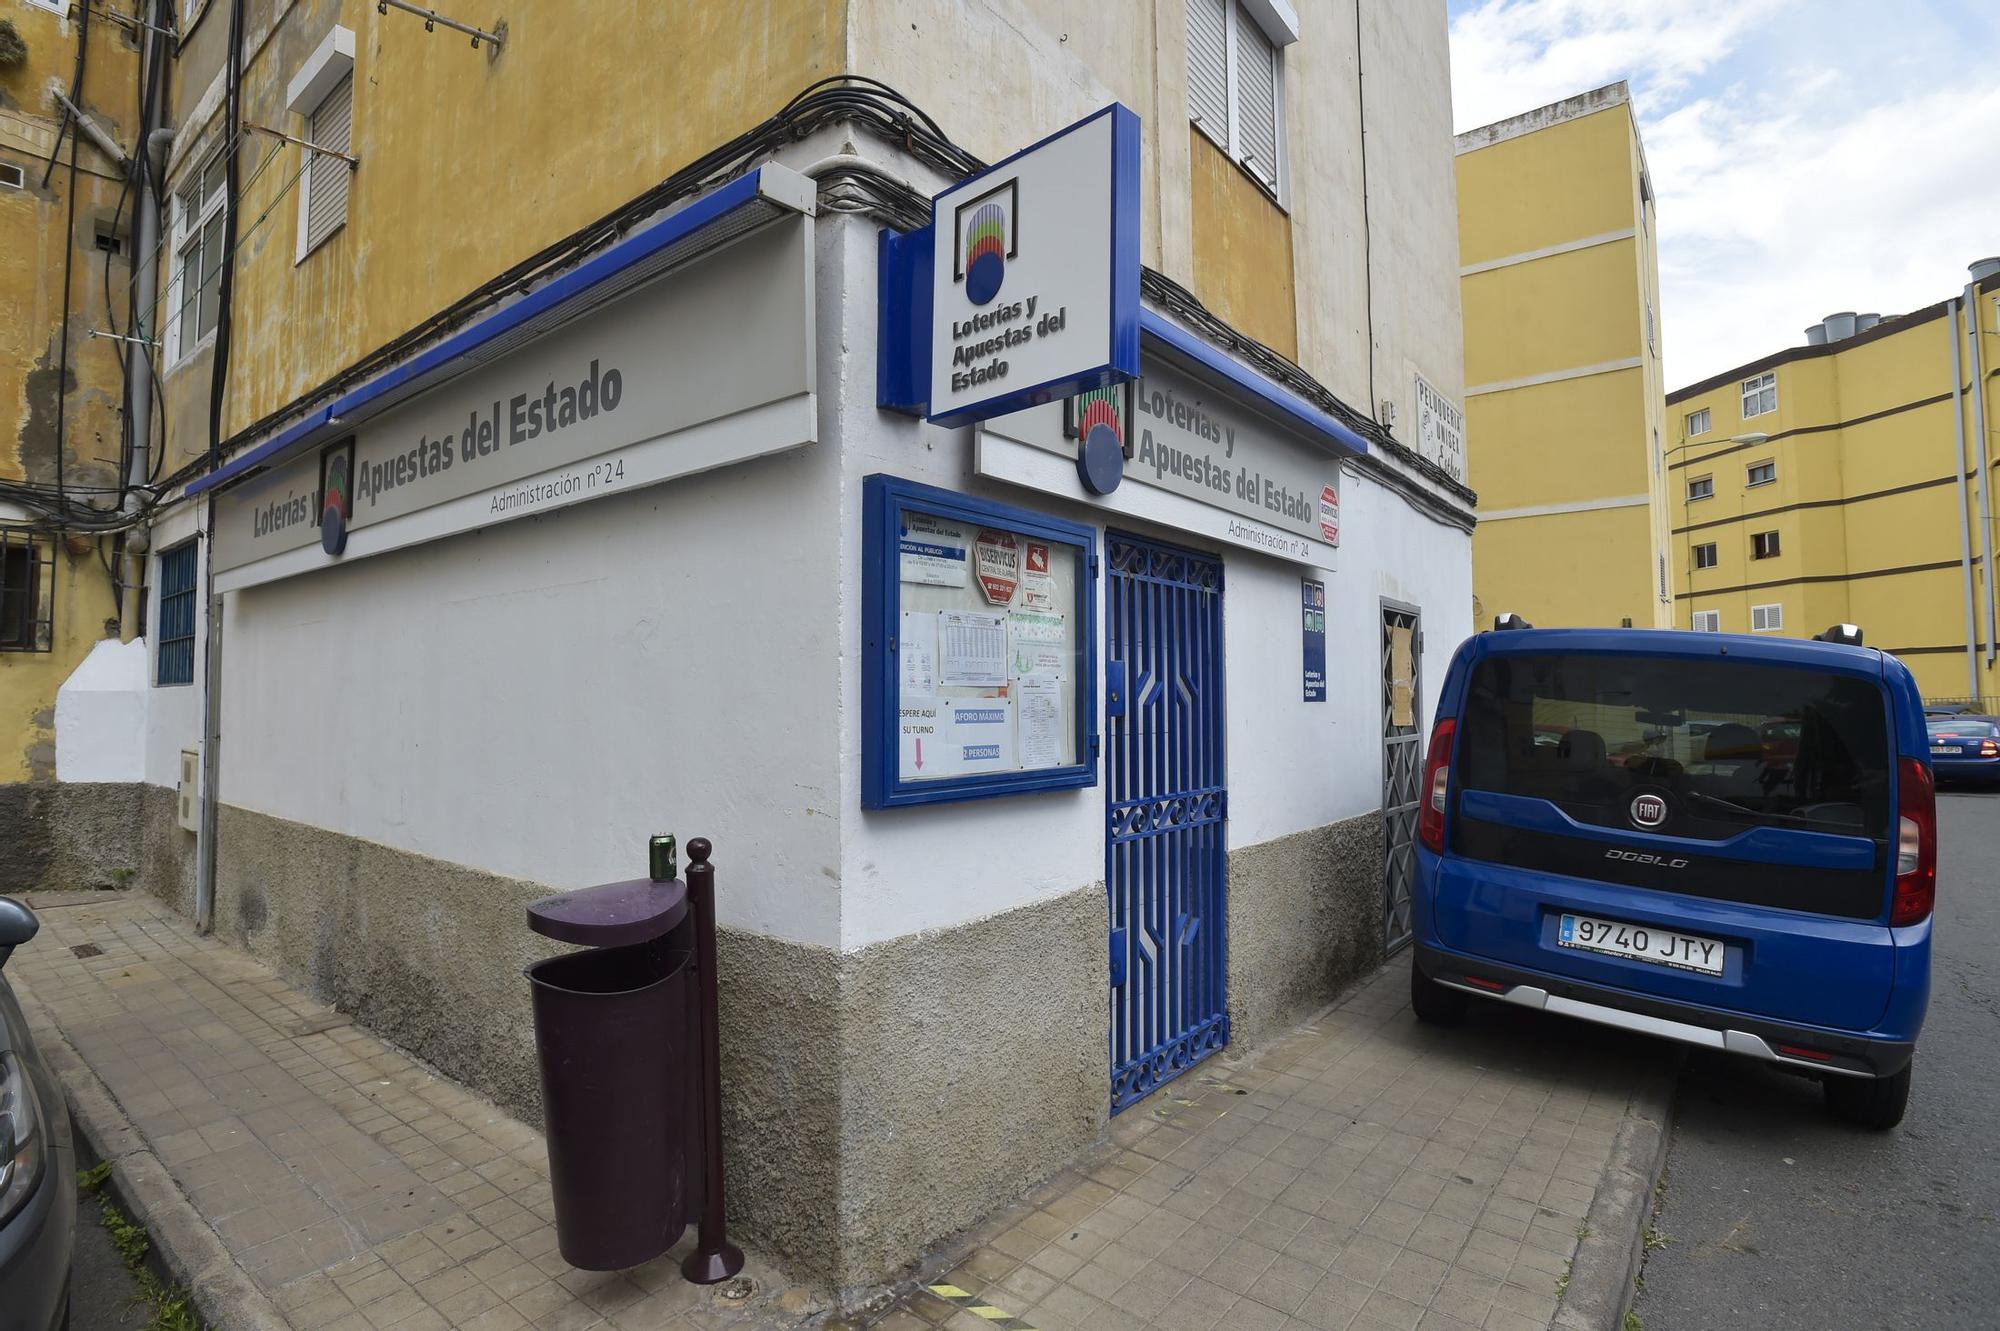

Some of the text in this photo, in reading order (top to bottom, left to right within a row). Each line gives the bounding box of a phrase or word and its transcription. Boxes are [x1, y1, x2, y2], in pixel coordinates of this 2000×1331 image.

[953, 295, 1038, 341] Loterías y
[953, 306, 1067, 368] Apuestas del
[951, 357, 1009, 393] Estado
[1138, 377, 1236, 459] Loterías y
[253, 359, 623, 538] Loterías y Apuestas del Estado
[1436, 420, 1460, 455] UNISEX
[489, 473, 581, 514] Administración
[1138, 428, 1312, 524] Apuestas del Estado
[1228, 520, 1288, 552] Administración
[899, 708, 937, 718] ESPERE AQUÍ
[903, 726, 934, 734] SU TURNO
[955, 712, 978, 721] AFORO
[969, 747, 999, 758] PERSONAS
[1638, 803, 1660, 818] FIAT
[1604, 849, 1689, 869] DOBLO
[1579, 921, 1715, 965] 9740 JTY
